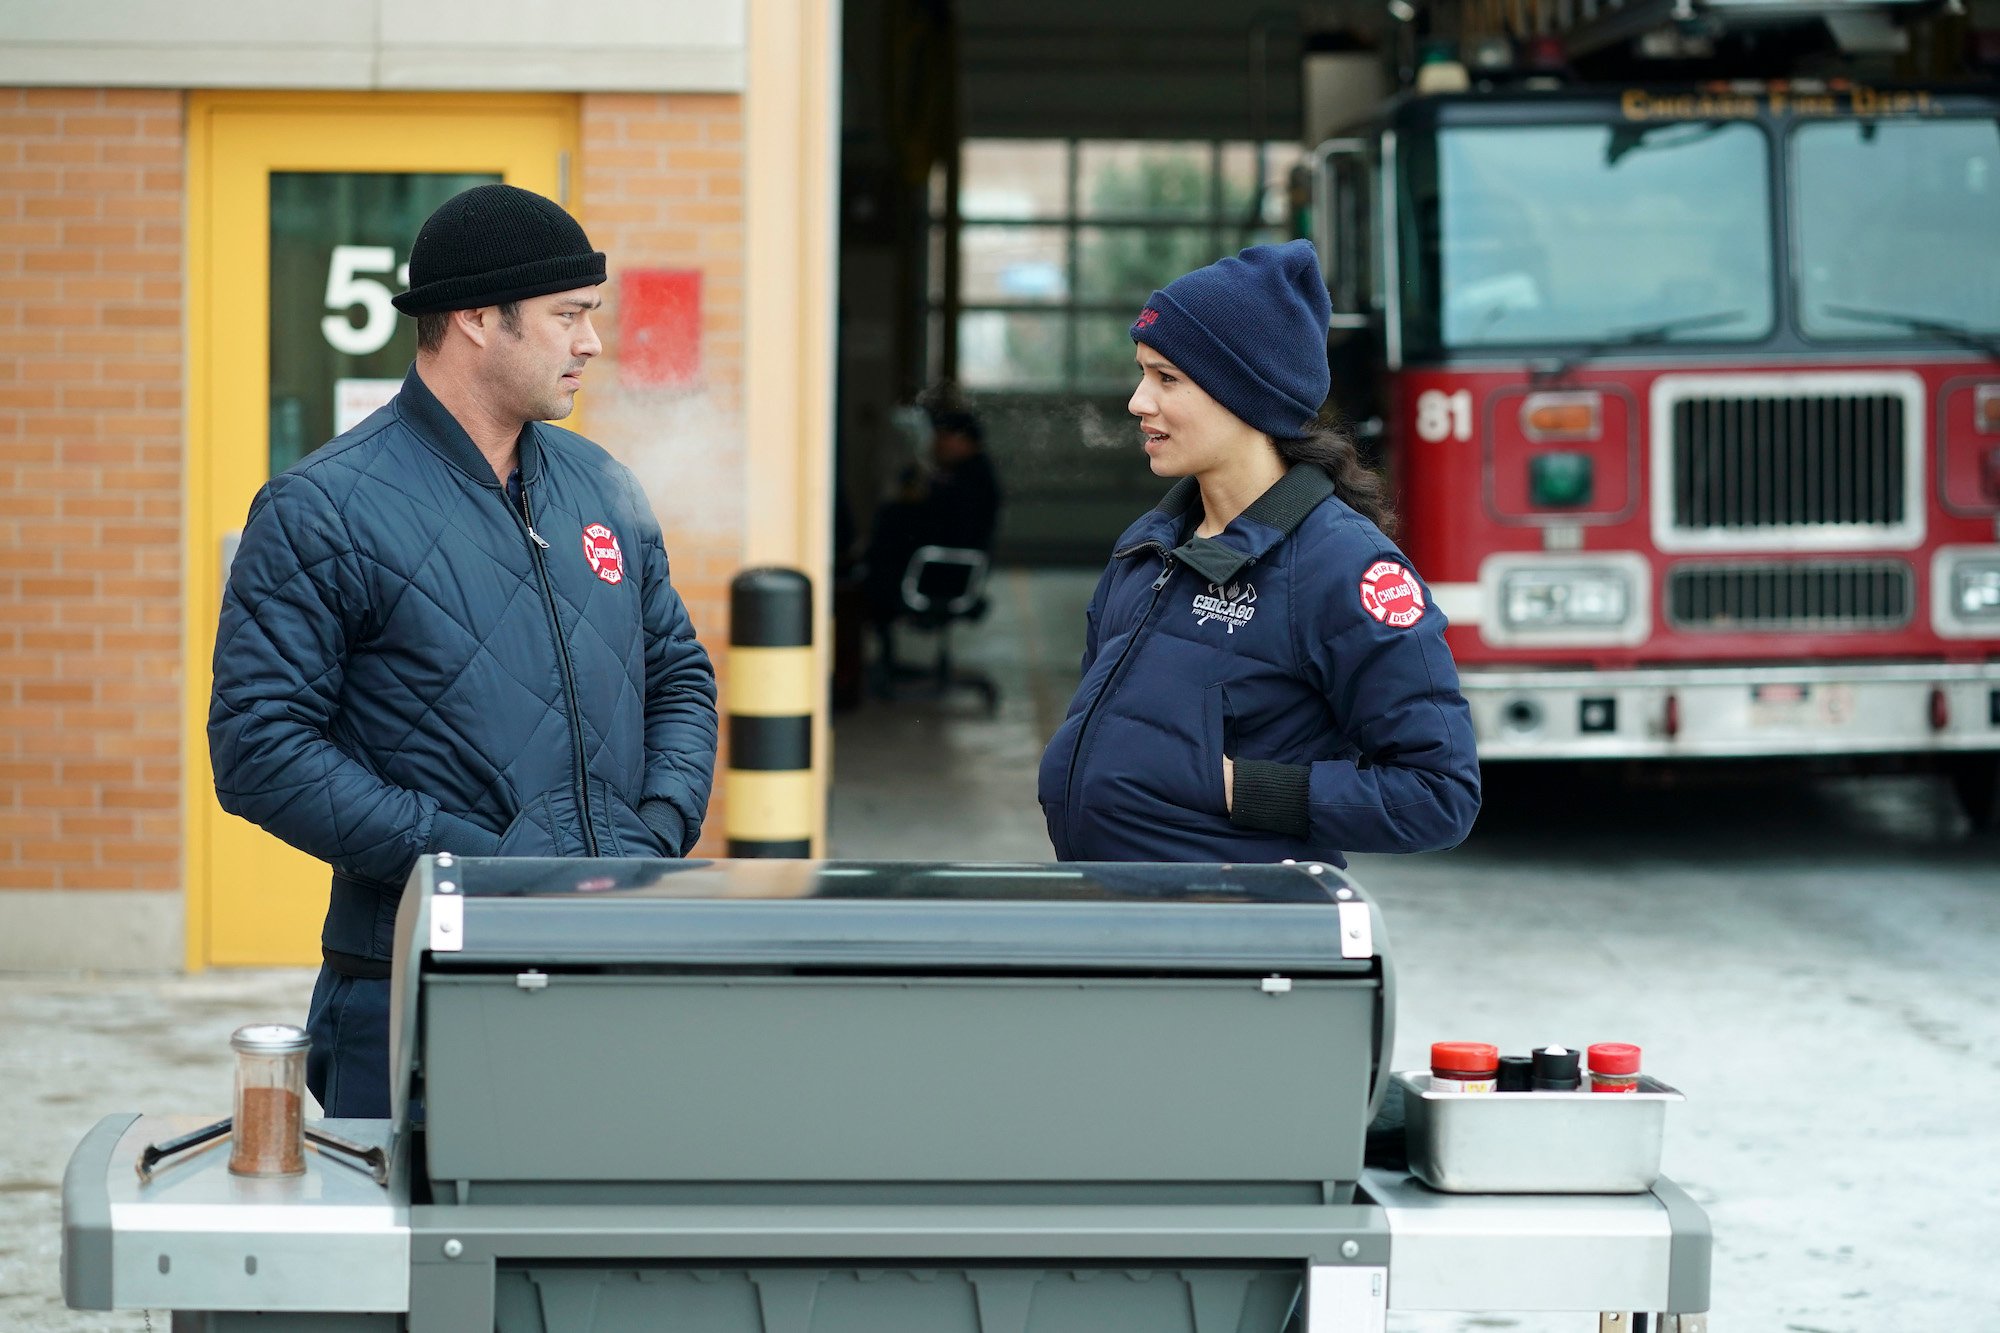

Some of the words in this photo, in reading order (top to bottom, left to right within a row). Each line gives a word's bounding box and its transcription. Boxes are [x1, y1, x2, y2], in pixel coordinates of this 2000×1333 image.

[320, 244, 410, 355] 5
[1416, 388, 1472, 443] 81
[591, 528, 608, 536] FIRE
[1373, 564, 1394, 577] FIRE
[1377, 583, 1411, 604] CHICAGO
[1191, 608, 1206, 617] FIRE
[1206, 611, 1247, 627] DEPARTMENT
[1192, 594, 1255, 621] CHICAGO
